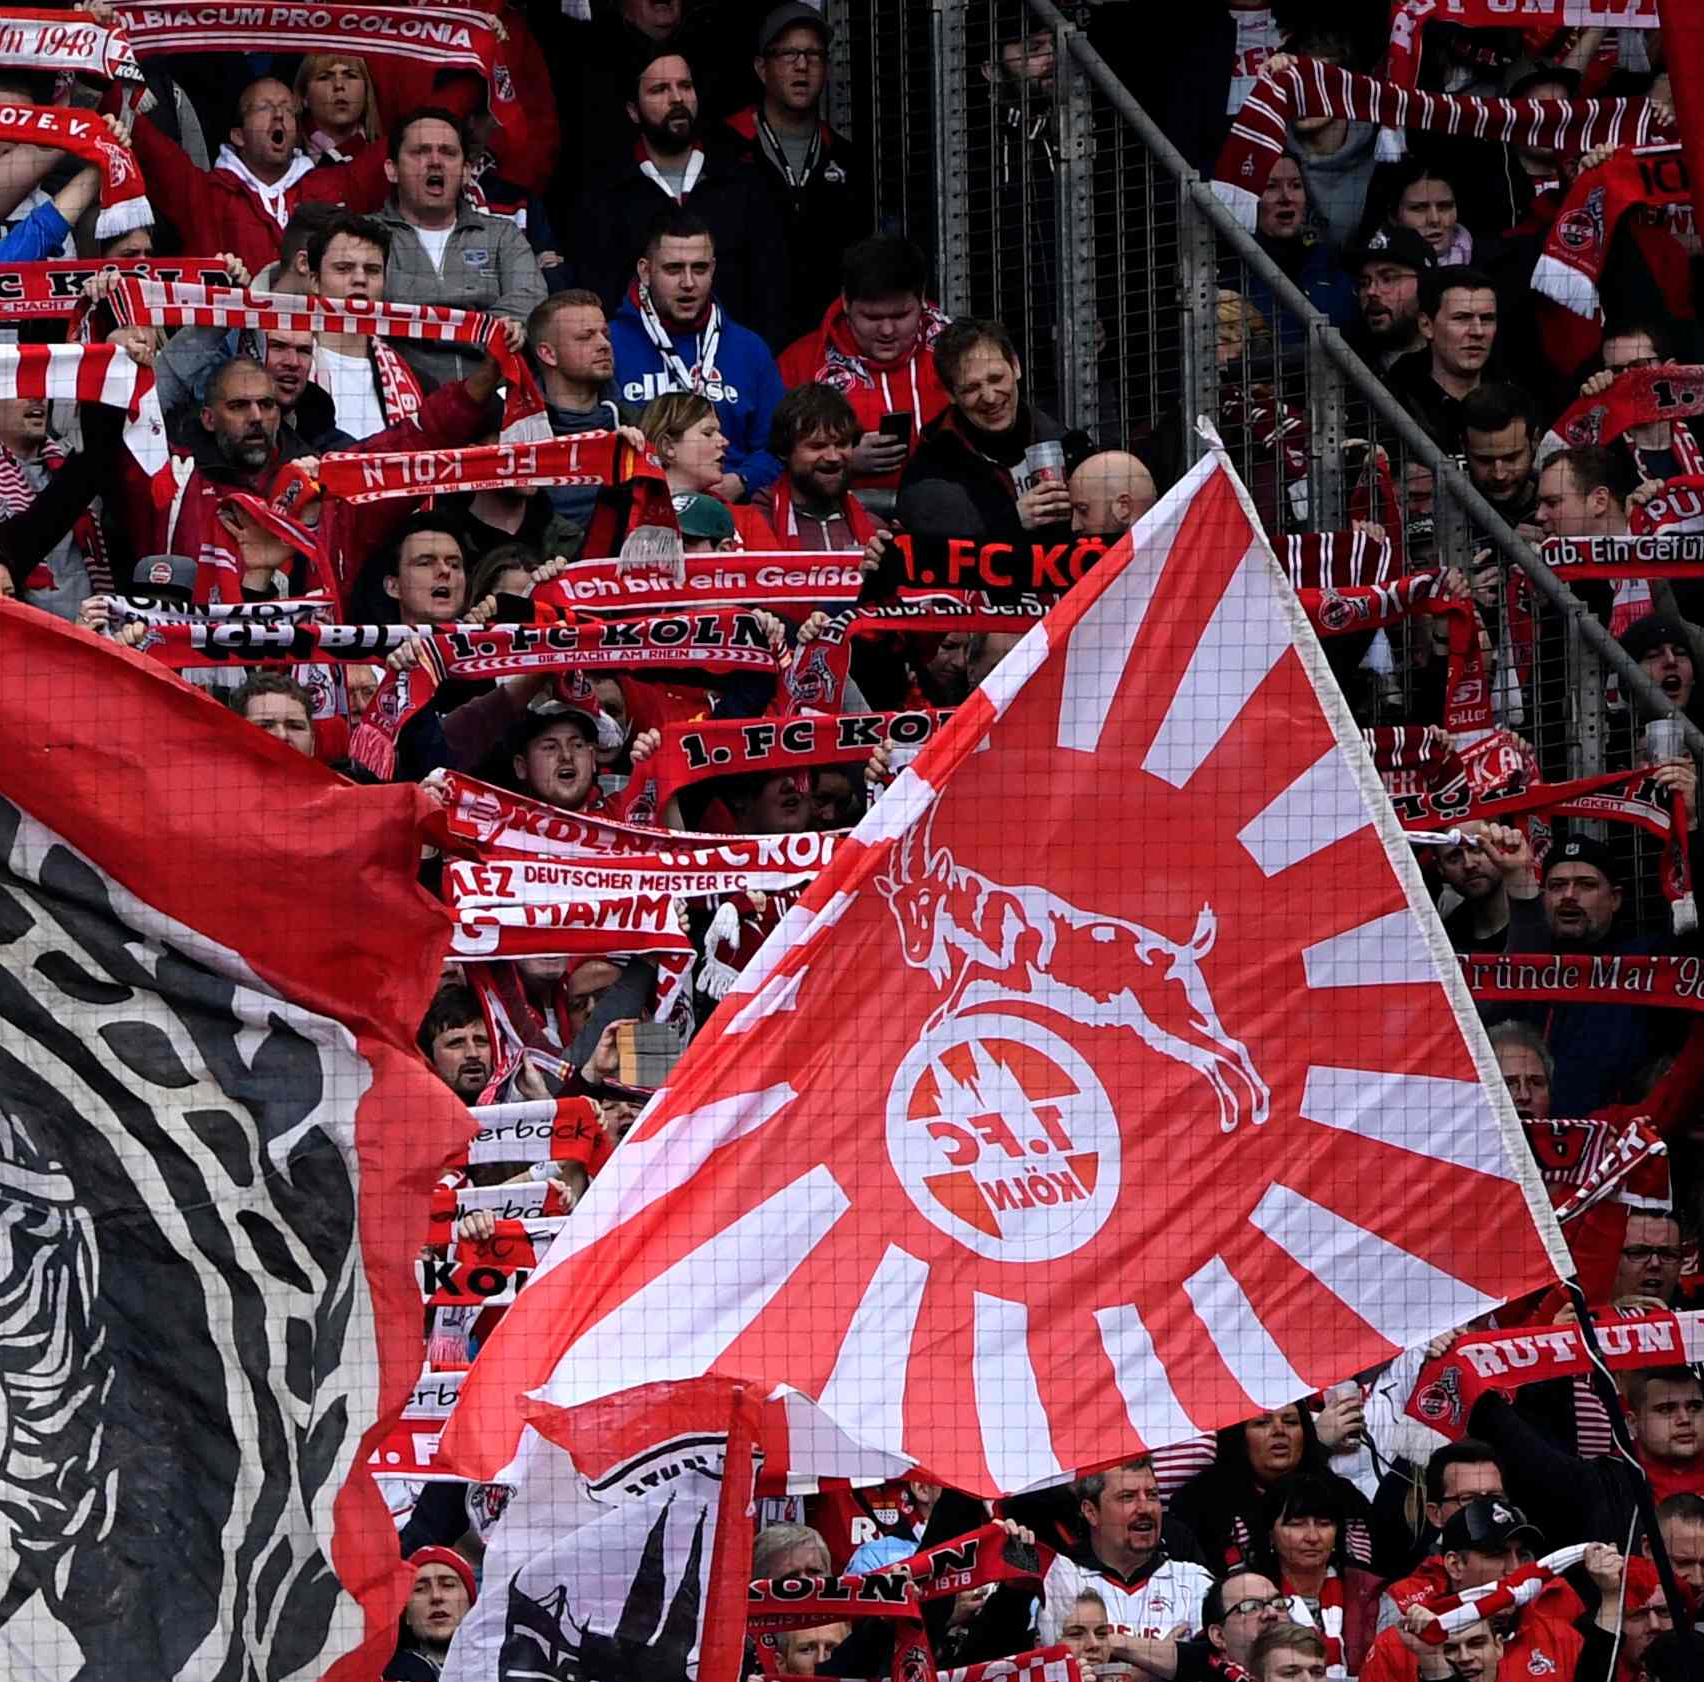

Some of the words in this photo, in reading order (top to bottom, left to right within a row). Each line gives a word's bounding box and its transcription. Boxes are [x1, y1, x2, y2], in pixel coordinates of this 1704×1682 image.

[36, 20, 97, 56] 1948
[264, 13, 331, 30] PRO
[340, 12, 473, 48] COLONIA
[947, 539, 1013, 586] FC
[561, 574, 616, 601] Ich
[690, 568, 745, 591] ein
[453, 628, 500, 654] 1.
[510, 623, 576, 647] FC
[683, 736, 729, 766] 1.
[744, 725, 816, 753] FC
[523, 868, 633, 890] DEUTSCHER
[641, 874, 716, 892] MEISTER
[724, 874, 748, 890] FC
[1591, 961, 1654, 990] Mai
